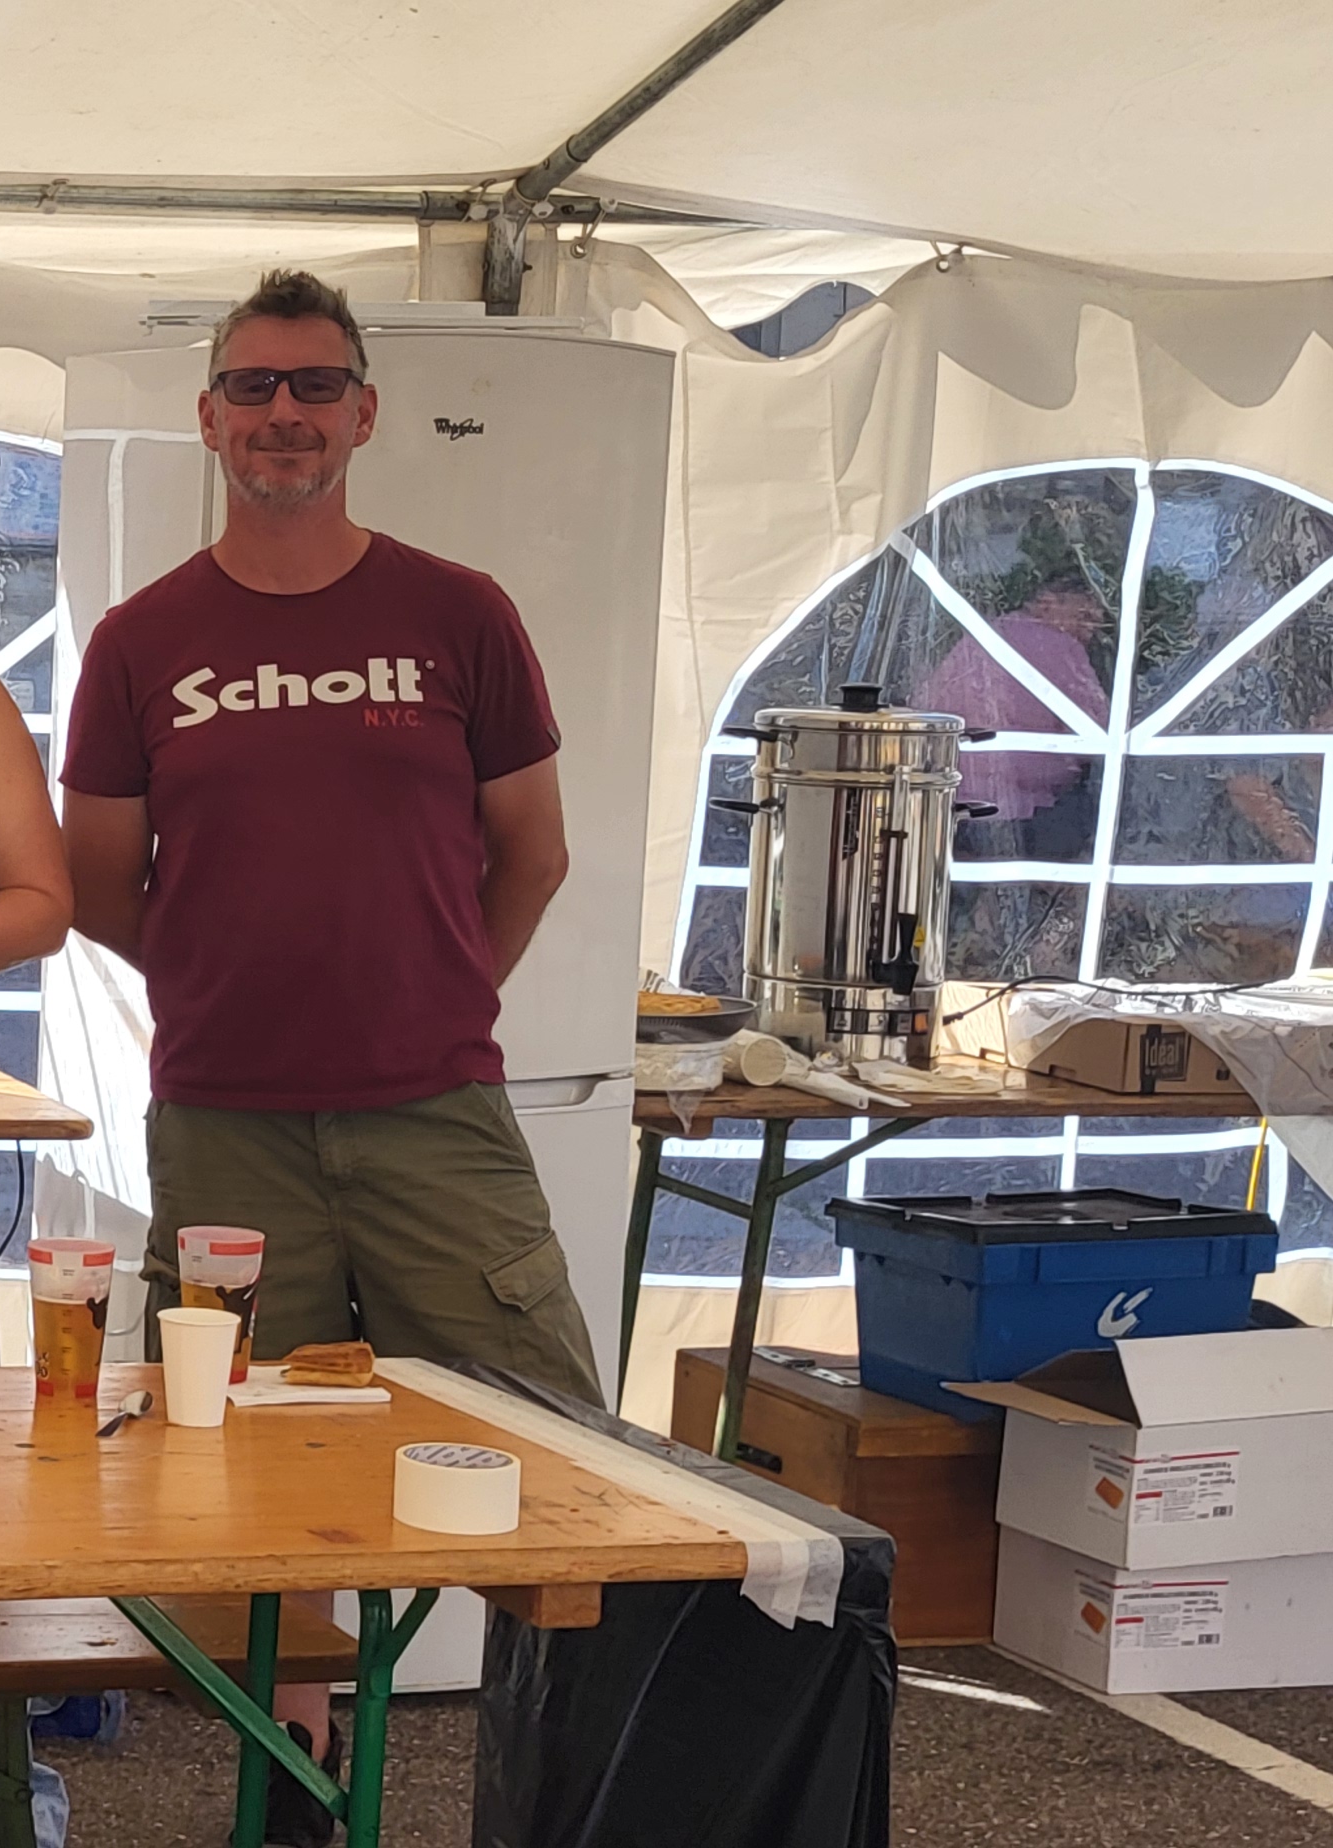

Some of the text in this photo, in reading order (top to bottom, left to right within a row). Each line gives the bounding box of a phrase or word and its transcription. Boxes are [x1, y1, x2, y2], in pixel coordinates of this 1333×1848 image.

[433, 418, 484, 441] Whirlpool
[172, 658, 424, 728] Schott
[364, 709, 424, 727] N.Y.C.
